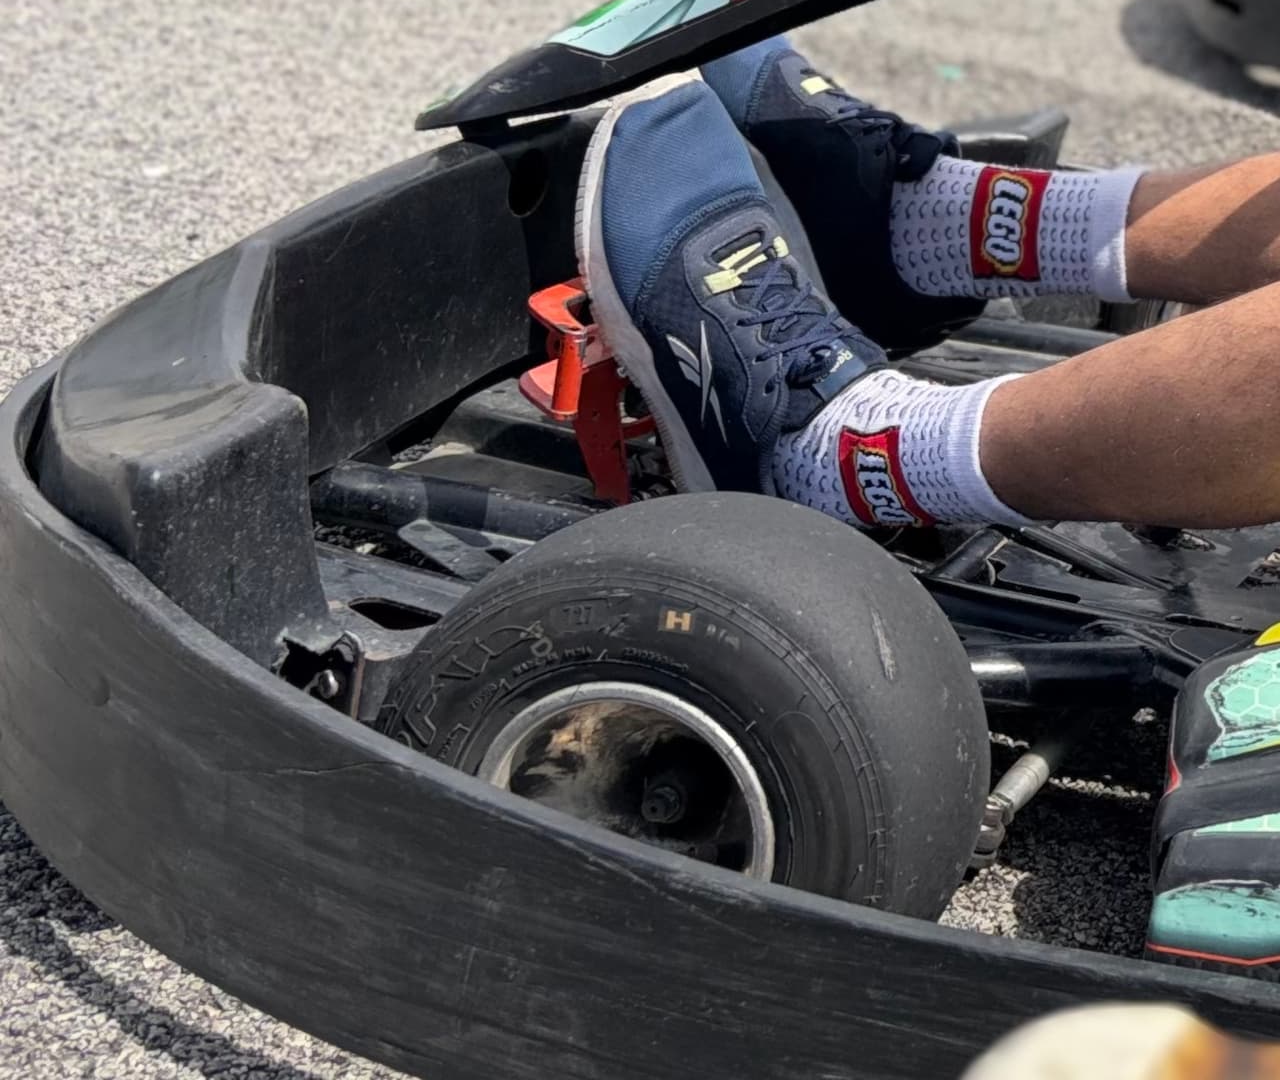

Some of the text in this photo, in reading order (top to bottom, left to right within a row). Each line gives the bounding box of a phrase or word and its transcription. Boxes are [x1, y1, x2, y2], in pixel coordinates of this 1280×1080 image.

[985, 178, 1029, 265] LEGO
[856, 450, 915, 525] LEGO
[664, 609, 693, 632] H
